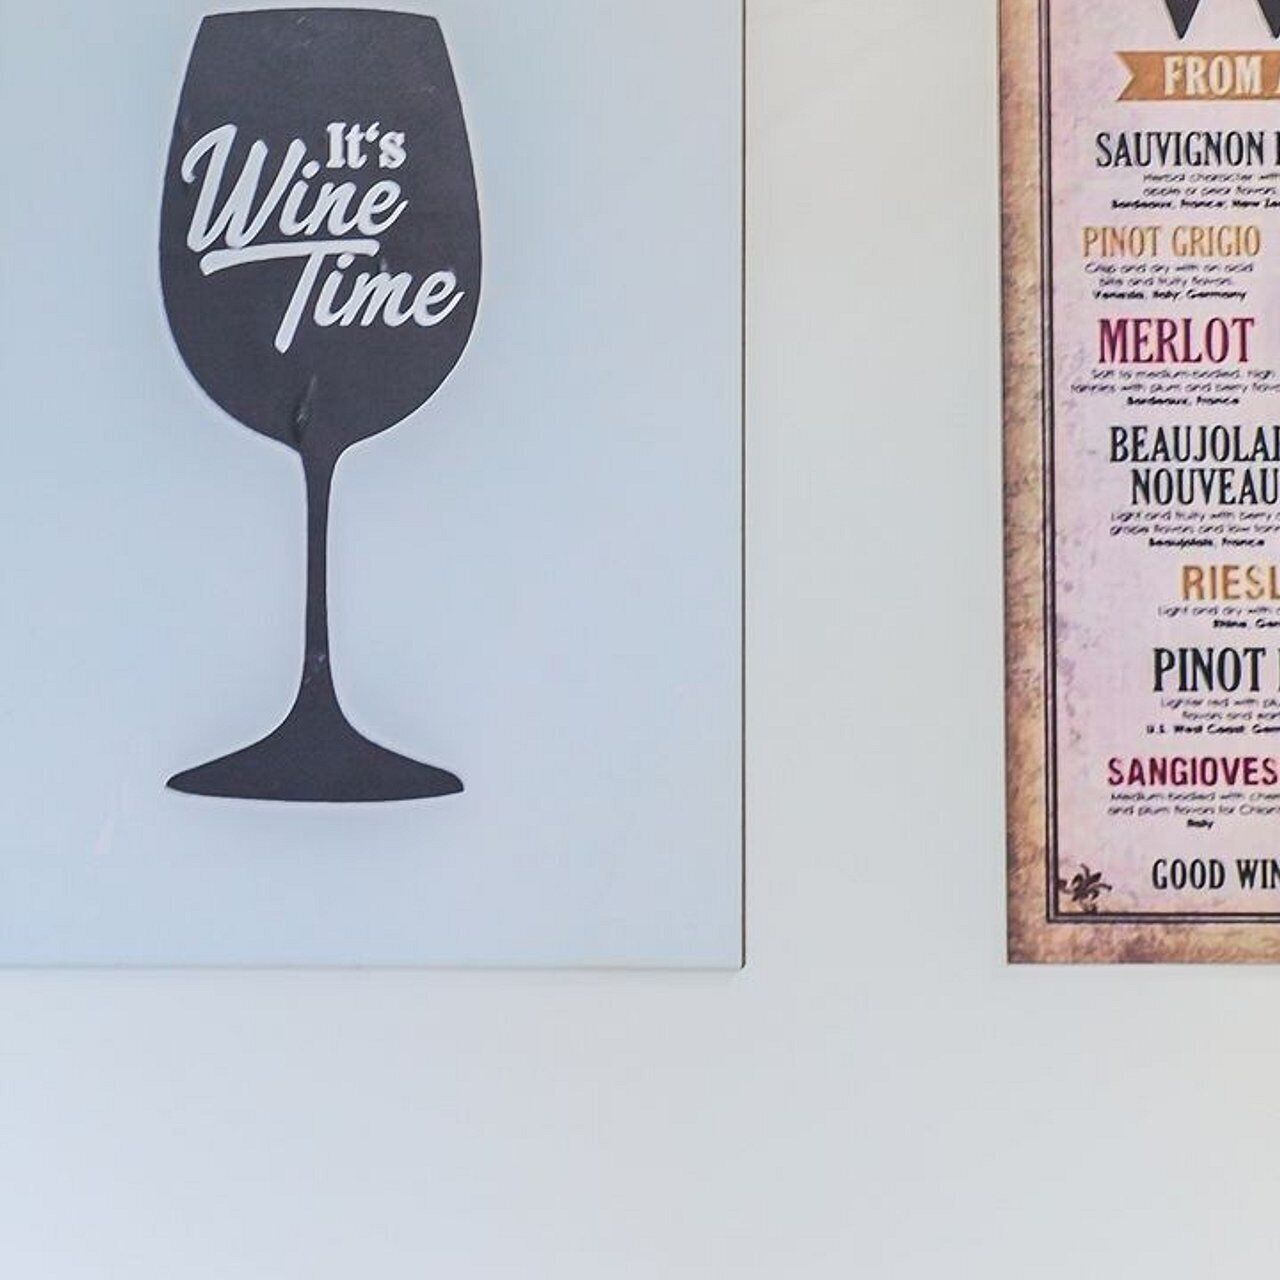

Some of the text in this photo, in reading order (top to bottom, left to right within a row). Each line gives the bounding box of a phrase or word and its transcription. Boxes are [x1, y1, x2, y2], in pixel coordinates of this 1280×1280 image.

[1164, 54, 1261, 96] FROM
[326, 122, 408, 169] It's
[1096, 131, 1264, 167] SAUVIGNON
[181, 124, 409, 253] Wine
[1084, 226, 1260, 257] PINOT GRIGIO
[200, 238, 465, 354] Time
[1099, 318, 1254, 363] MERLOT
[1132, 468, 1278, 505] NOUVEAU
[1154, 647, 1266, 692] PINOT
[1152, 859, 1225, 889] GOOD
